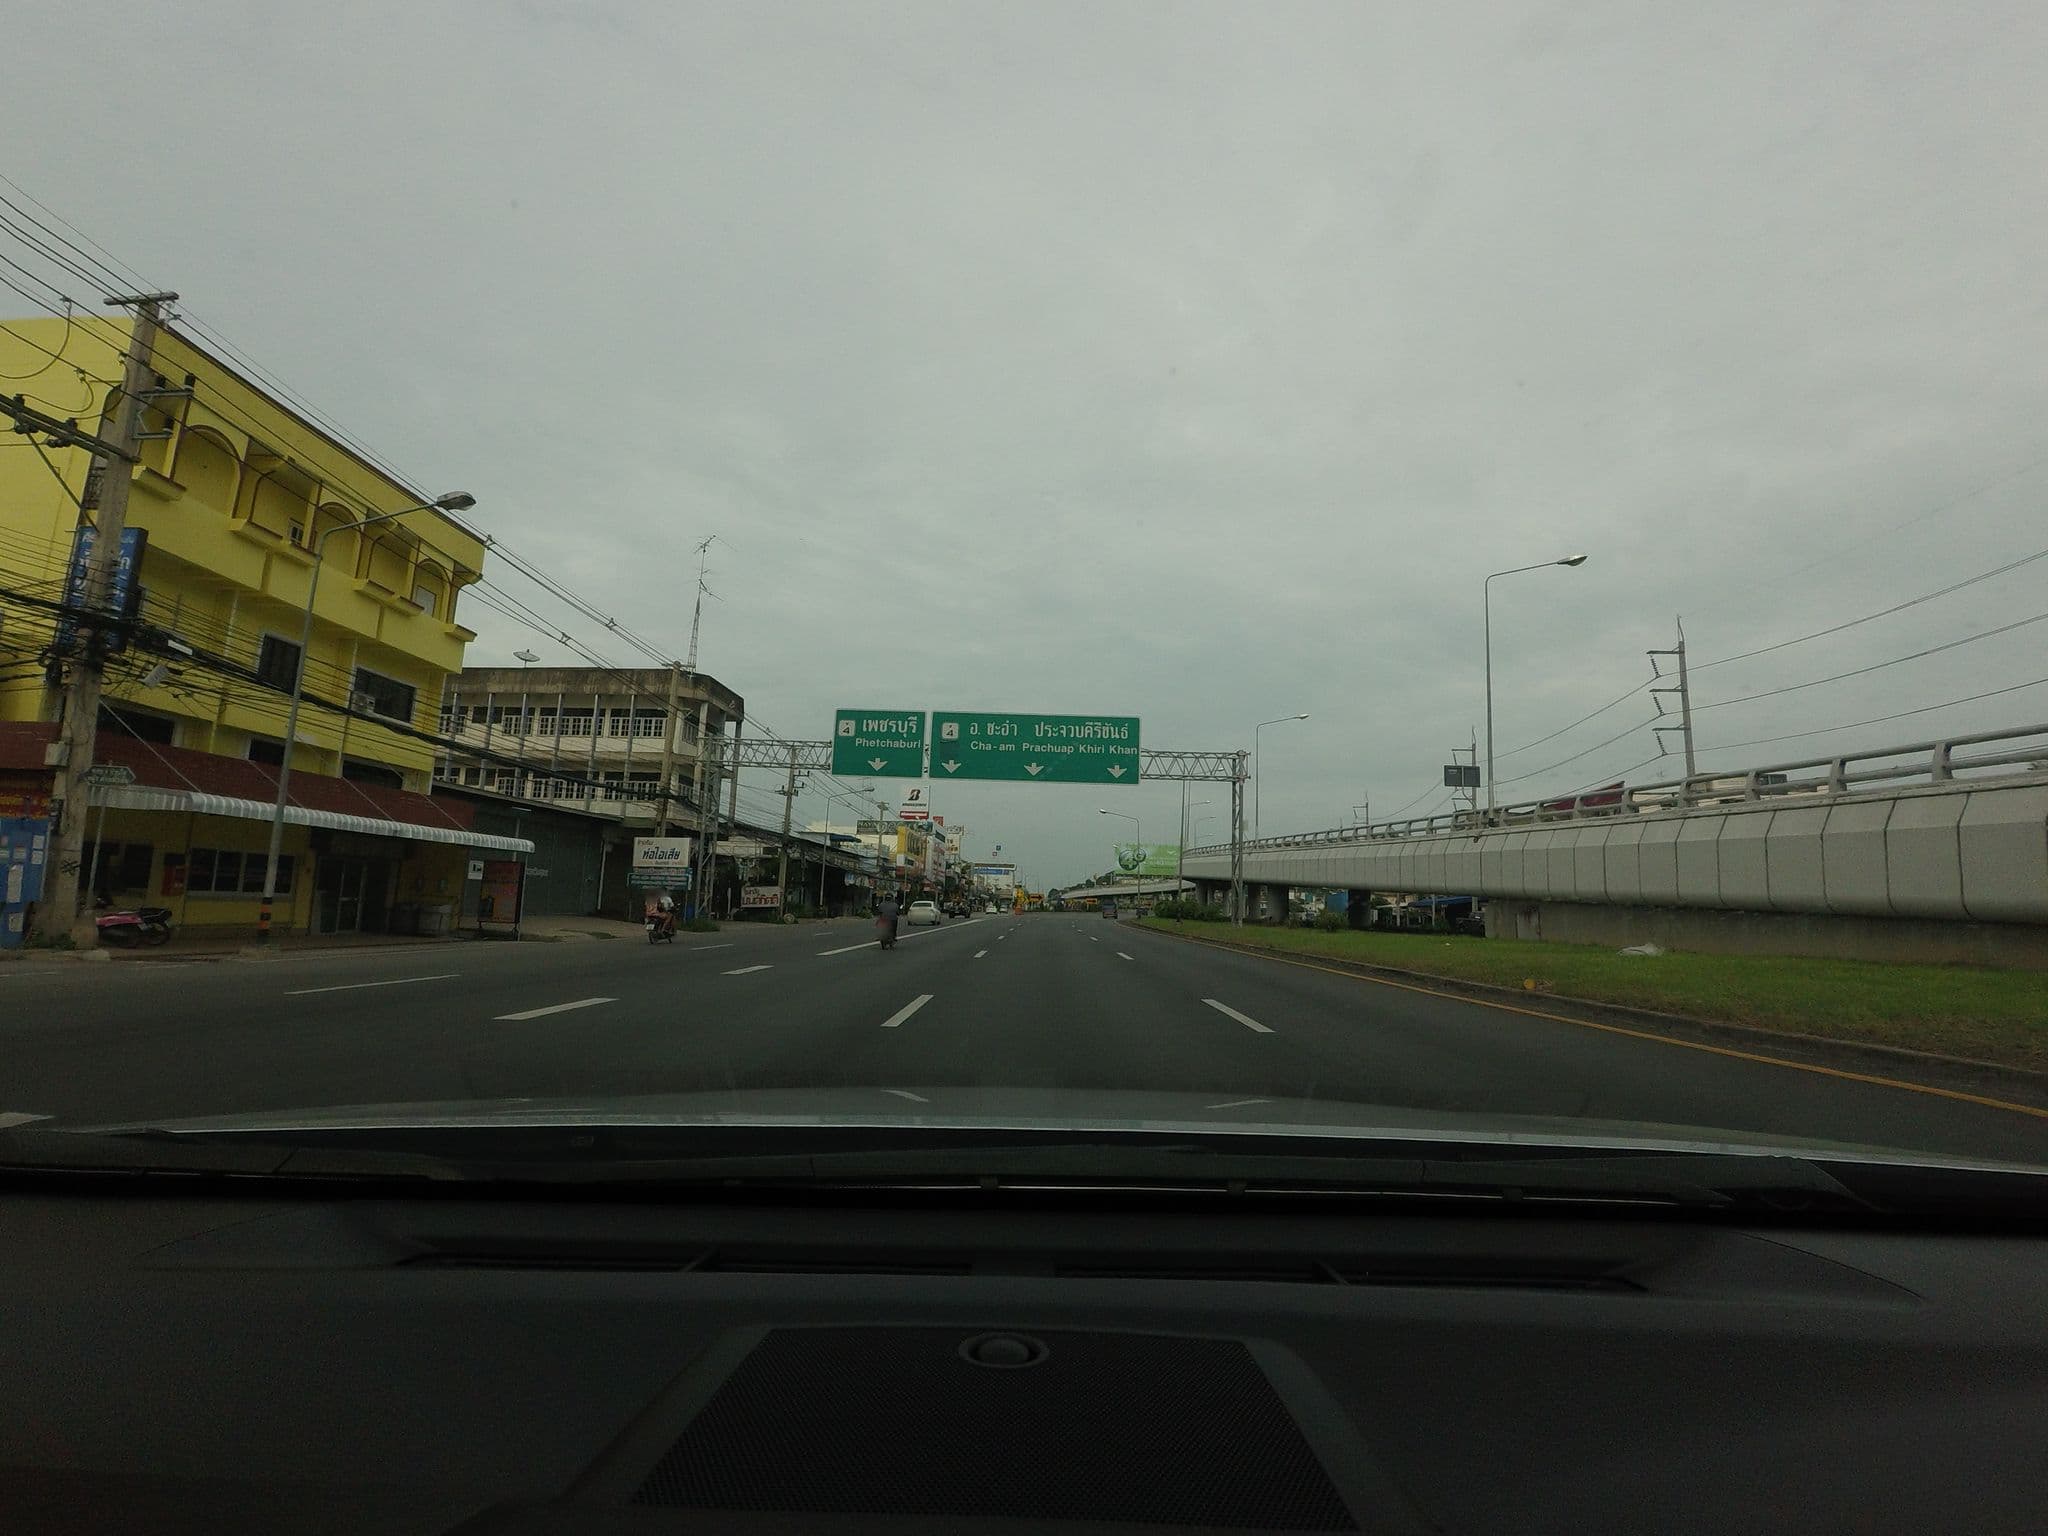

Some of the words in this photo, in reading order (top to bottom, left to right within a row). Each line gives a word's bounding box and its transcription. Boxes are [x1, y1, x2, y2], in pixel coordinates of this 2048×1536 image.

[862, 716, 917, 737] เพชรบุรี
[970, 722, 980, 735] อ.
[987, 720, 1018, 736] ชะอำ
[1034, 721, 1129, 739] ประจวบคีรีขันธ์
[855, 738, 921, 748] Phetchaburi
[1022, 743, 1075, 755] Prachuap
[1079, 745, 1105, 754] Khiri
[1109, 745, 1138, 755] Khan
[642, 846, 681, 860] ท่อไอเสีย
